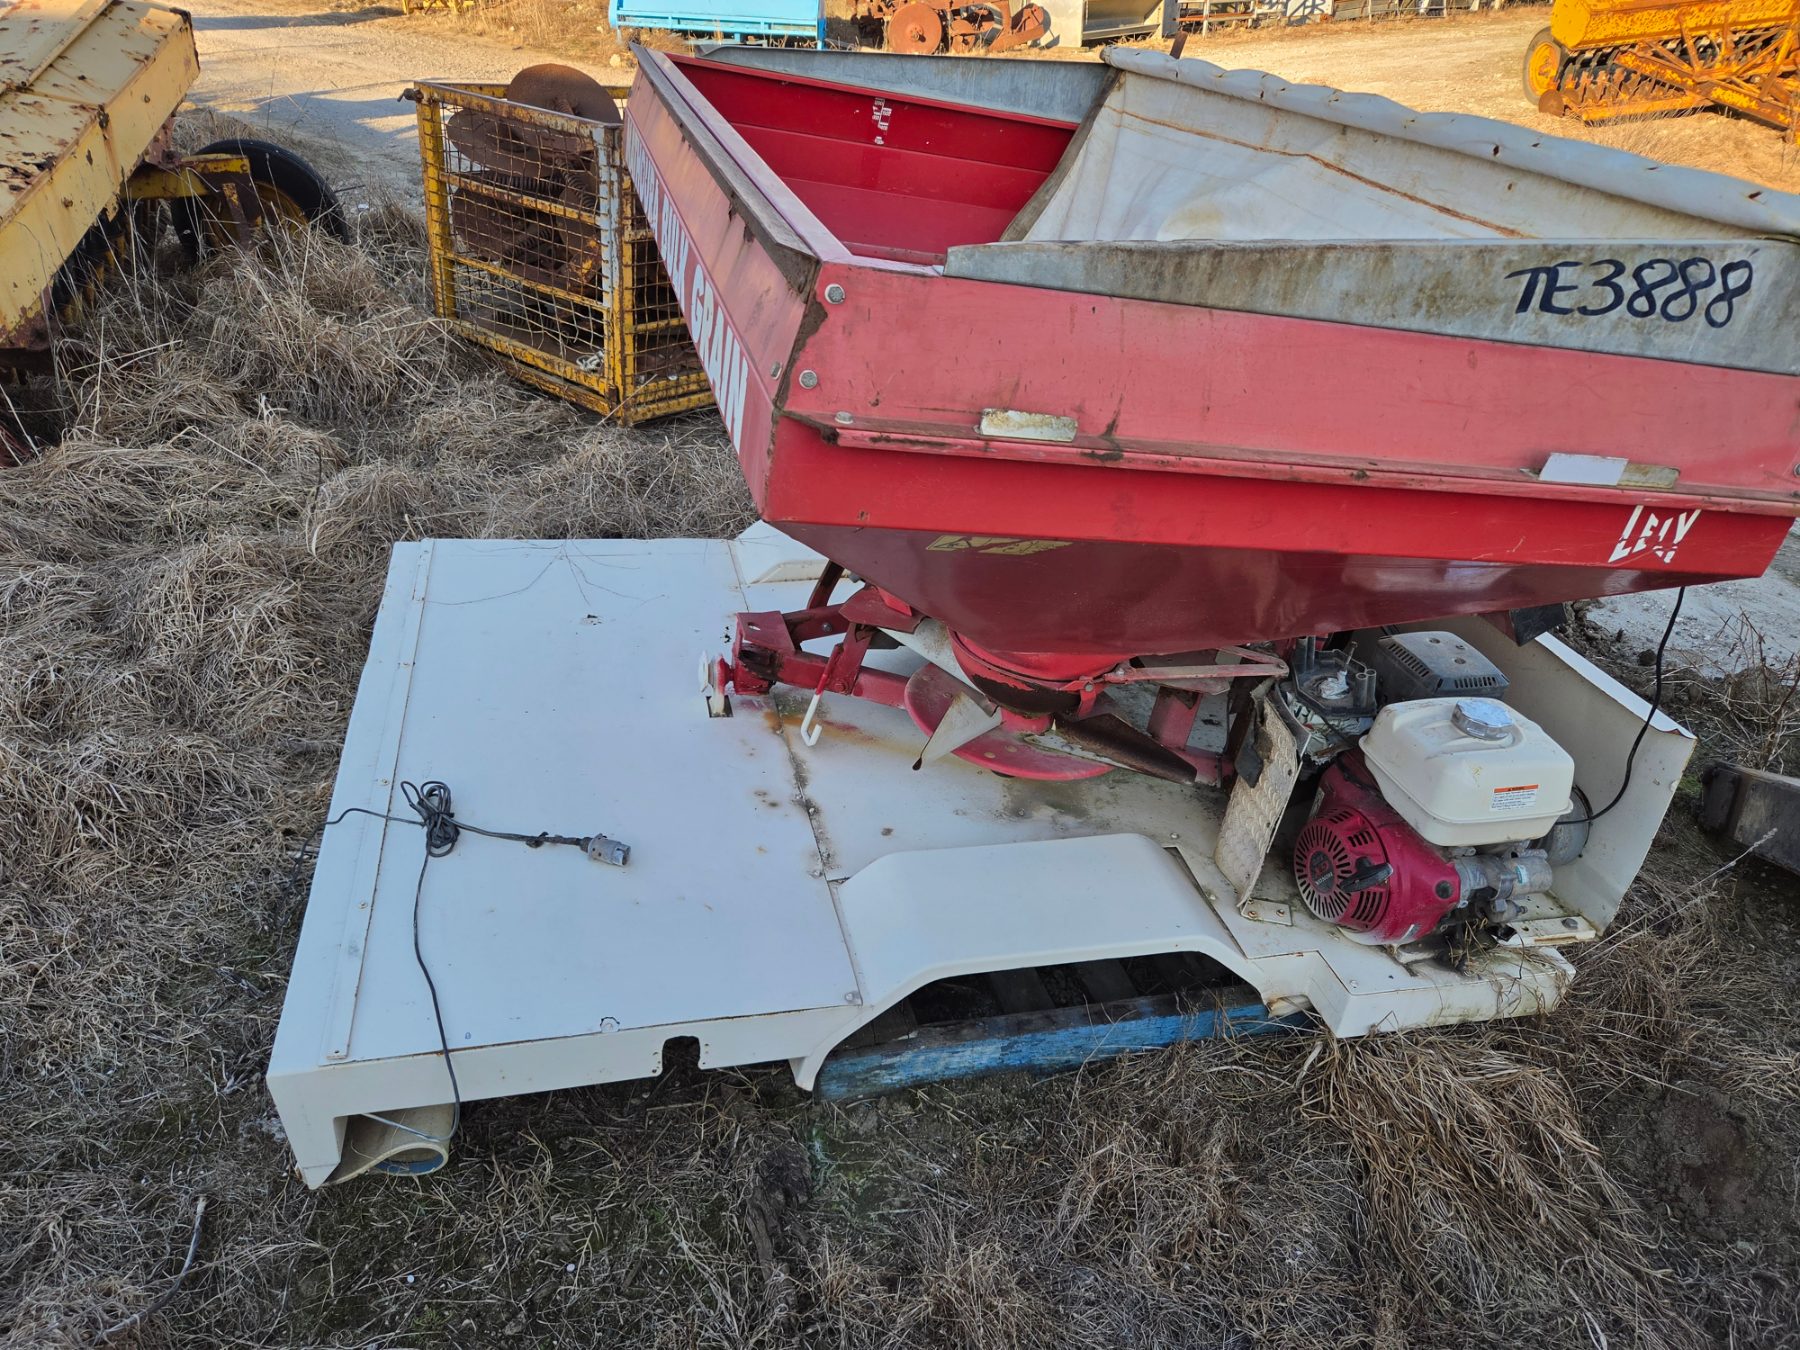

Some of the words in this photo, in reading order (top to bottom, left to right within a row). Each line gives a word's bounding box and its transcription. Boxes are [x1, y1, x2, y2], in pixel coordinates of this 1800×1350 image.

[660, 191, 690, 314] BULK
[691, 264, 749, 455] GRAIN
[1504, 257, 1753, 328] TE3888
